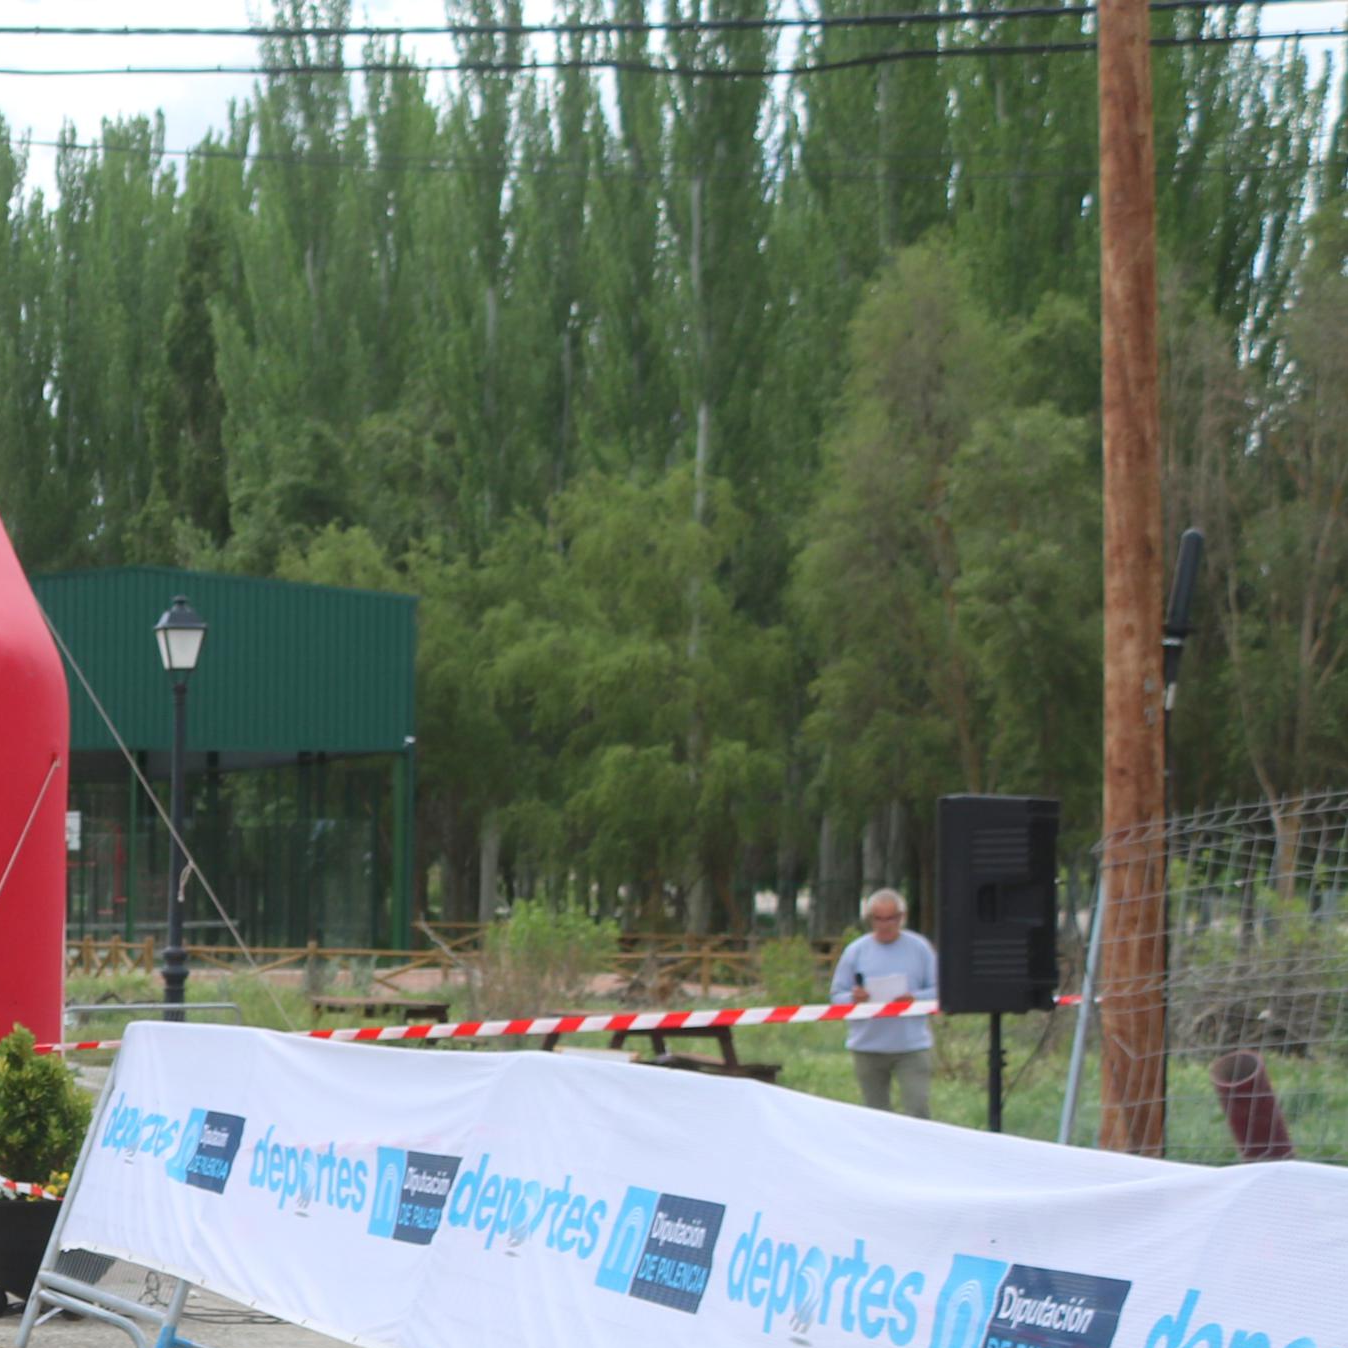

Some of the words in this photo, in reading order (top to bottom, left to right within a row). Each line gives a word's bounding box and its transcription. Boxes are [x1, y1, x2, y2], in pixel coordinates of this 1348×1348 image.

[249, 1124, 369, 1213] deportes
[447, 1154, 608, 1260] deportes
[650, 1211, 707, 1249] Diputación
[726, 1211, 925, 1348] deportes
[998, 1285, 1095, 1334] Diputación
